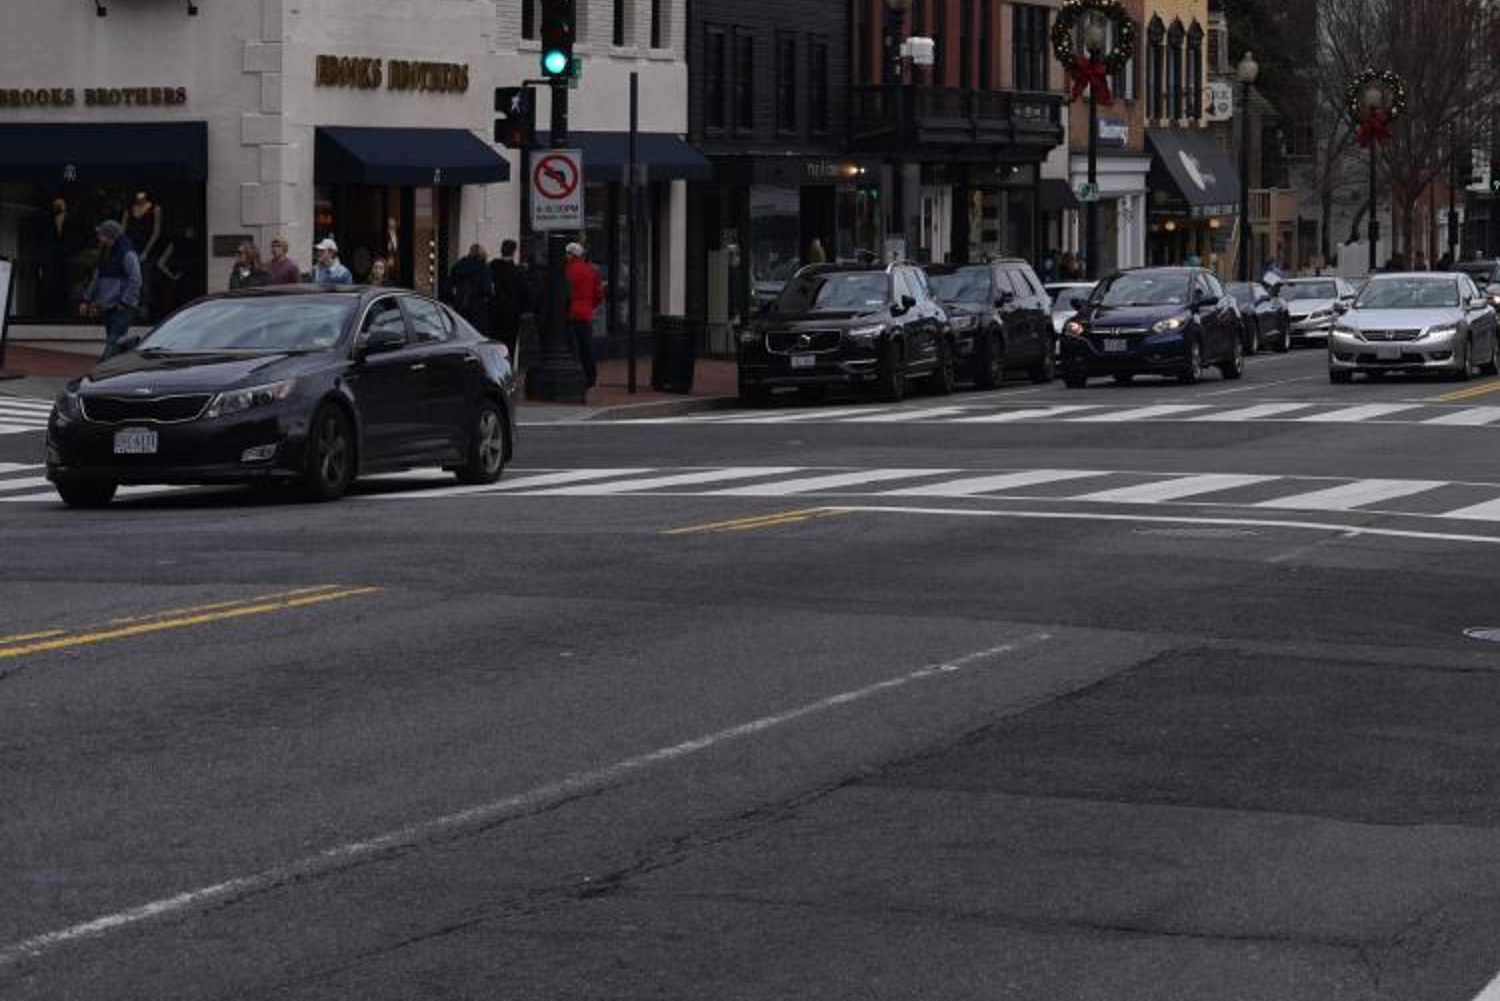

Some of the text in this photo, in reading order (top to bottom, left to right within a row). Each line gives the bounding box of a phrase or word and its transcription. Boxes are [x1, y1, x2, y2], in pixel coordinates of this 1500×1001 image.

[315, 54, 469, 95] BROOKS BROTHERS
[84, 86, 187, 106] BROTHERS
